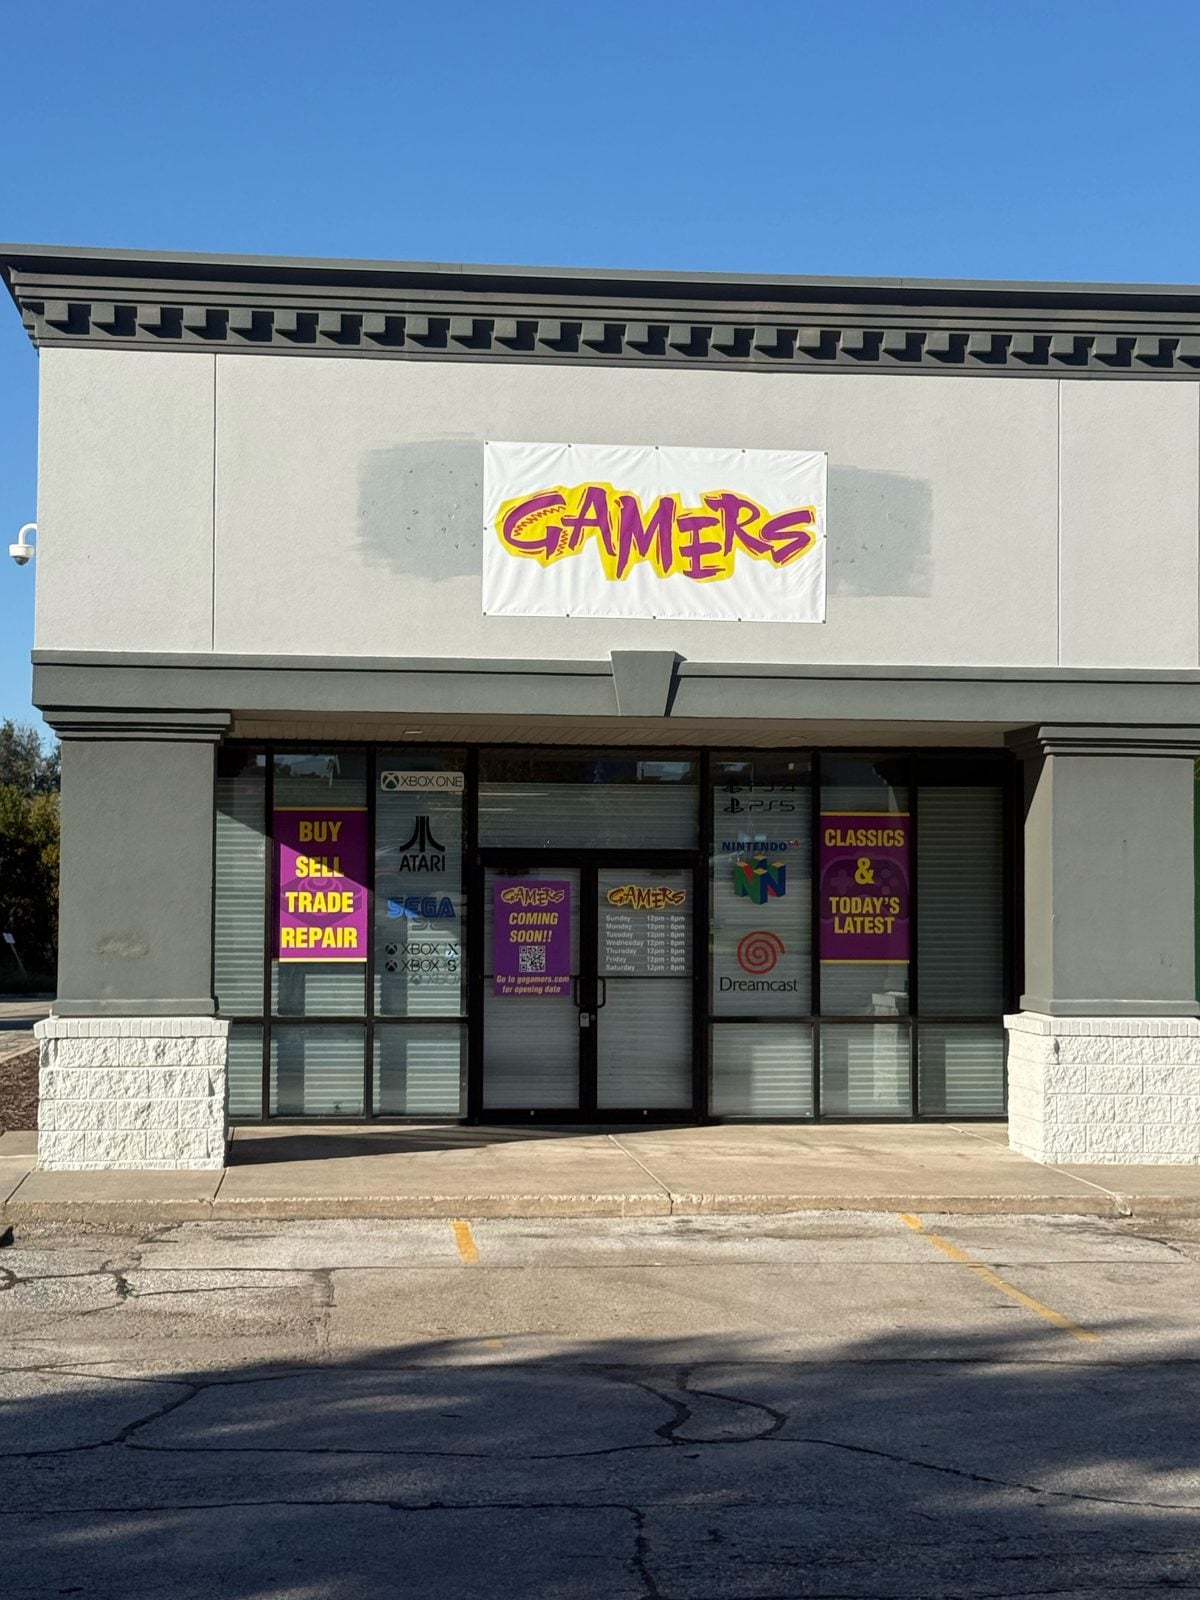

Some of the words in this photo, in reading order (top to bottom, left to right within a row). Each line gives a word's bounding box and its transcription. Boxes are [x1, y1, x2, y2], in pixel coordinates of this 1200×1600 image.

[502, 486, 815, 580] GAMERS
[401, 776, 435, 787] XBOX
[436, 776, 463, 787] ONE
[749, 800, 796, 812] PS5
[299, 821, 342, 842] BUY
[824, 829, 905, 847] CLASSICS
[722, 842, 787, 851] NINTENDO
[296, 856, 344, 878] SELL
[399, 855, 446, 872] ATARI
[854, 857, 875, 885] &
[285, 892, 354, 913] TRADE
[501, 887, 565, 906] GAMERS
[608, 886, 686, 909] GAMERS
[387, 896, 456, 919] SEGA
[829, 896, 900, 914] TODAY'S
[509, 912, 559, 925] COMING
[834, 916, 895, 934] LATEST
[606, 923, 632, 931] Monday
[281, 927, 357, 949] REPAIR
[509, 930, 553, 943] SOON!!
[401, 943, 440, 955] XBOX
[401, 960, 440, 972] XBOX
[606, 956, 626, 964] Friday
[606, 964, 636, 972] Saturday
[496, 975, 506, 983] Go
[508, 975, 516, 983] to
[517, 975, 570, 984] gogamers.com
[720, 977, 799, 992] Dreamcast
[502, 985, 512, 993] for
[514, 986, 543, 994] opening
[544, 985, 561, 993] date
